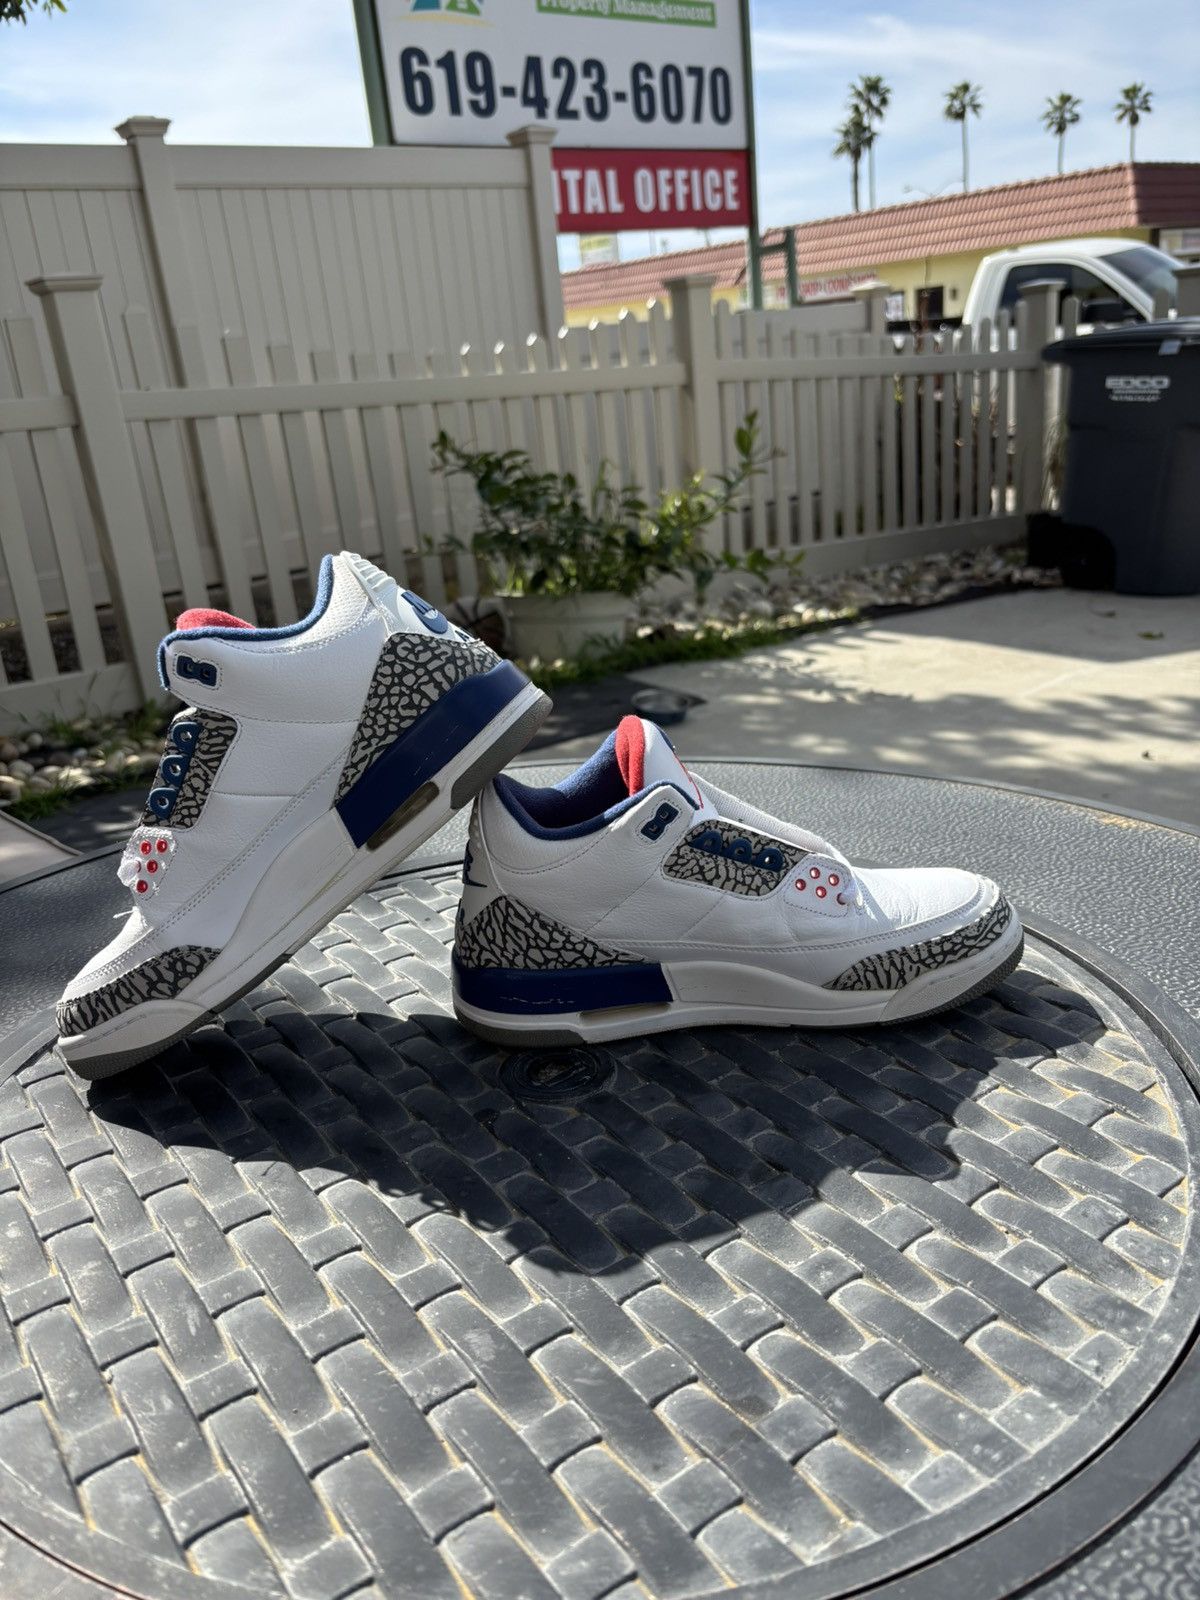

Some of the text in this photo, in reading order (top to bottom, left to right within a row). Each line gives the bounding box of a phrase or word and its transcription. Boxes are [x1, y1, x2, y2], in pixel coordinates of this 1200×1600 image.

[613, 0, 713, 21] Management
[400, 46, 732, 125] 619-423-6070
[634, 168, 740, 213] OFFICE
[1105, 375, 1170, 389] EDCO
